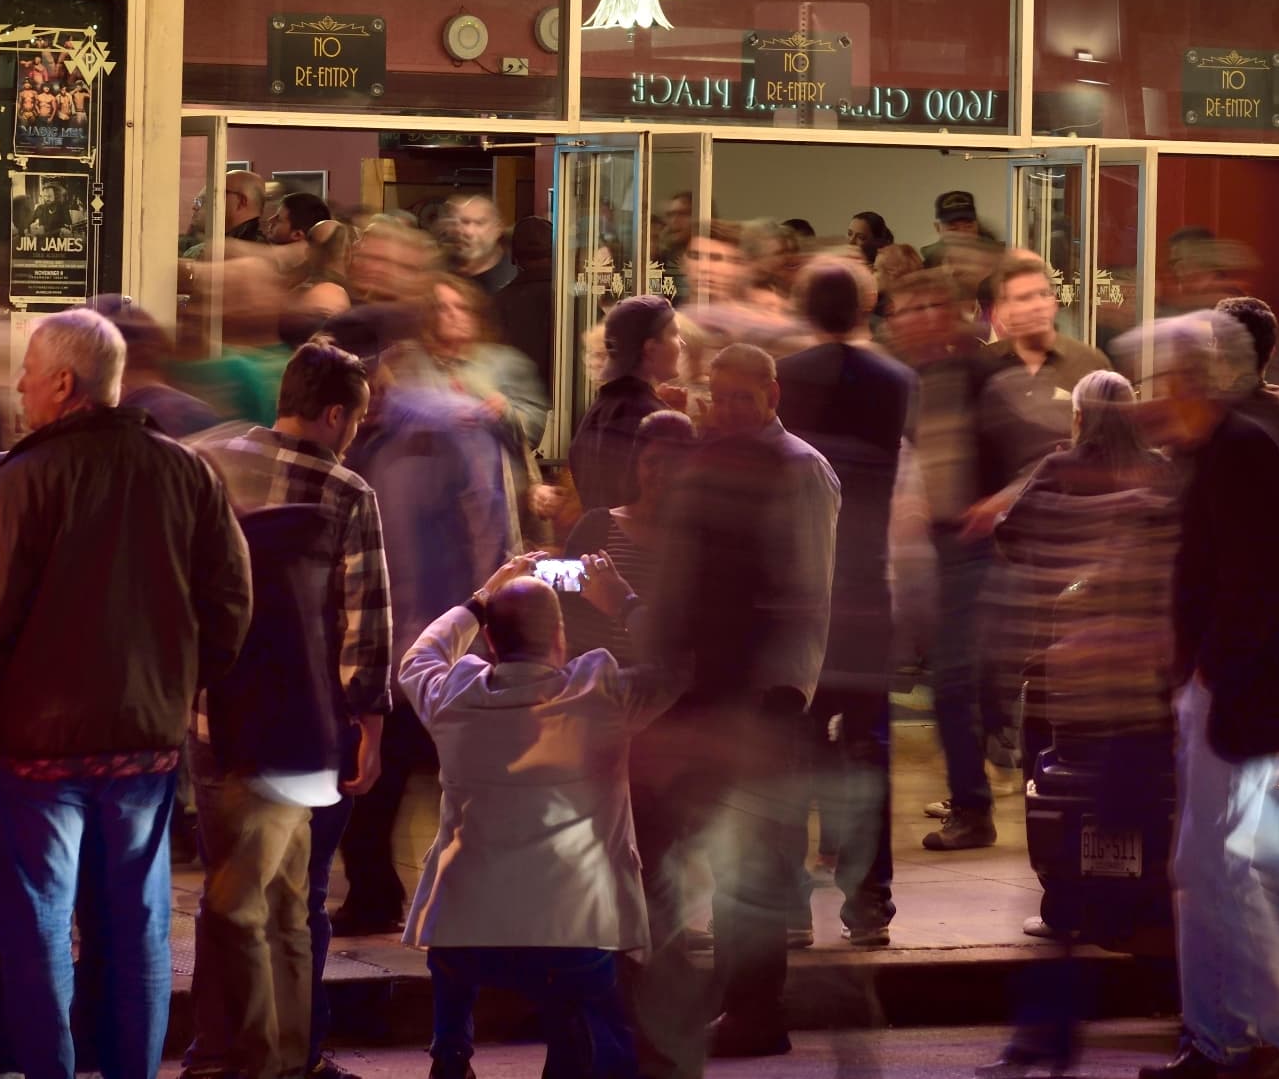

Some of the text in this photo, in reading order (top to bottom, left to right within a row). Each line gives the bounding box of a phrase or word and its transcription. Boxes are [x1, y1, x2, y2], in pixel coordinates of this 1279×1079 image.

[314, 37, 341, 58] NO
[784, 52, 810, 73] NO
[296, 67, 359, 89] RE-ENTRY
[1222, 70, 1246, 90] NO
[768, 81, 826, 102] RE-ENTRY
[1206, 98, 1261, 118] RE-ENTRY
[16, 236, 83, 252] JIM JAMES
